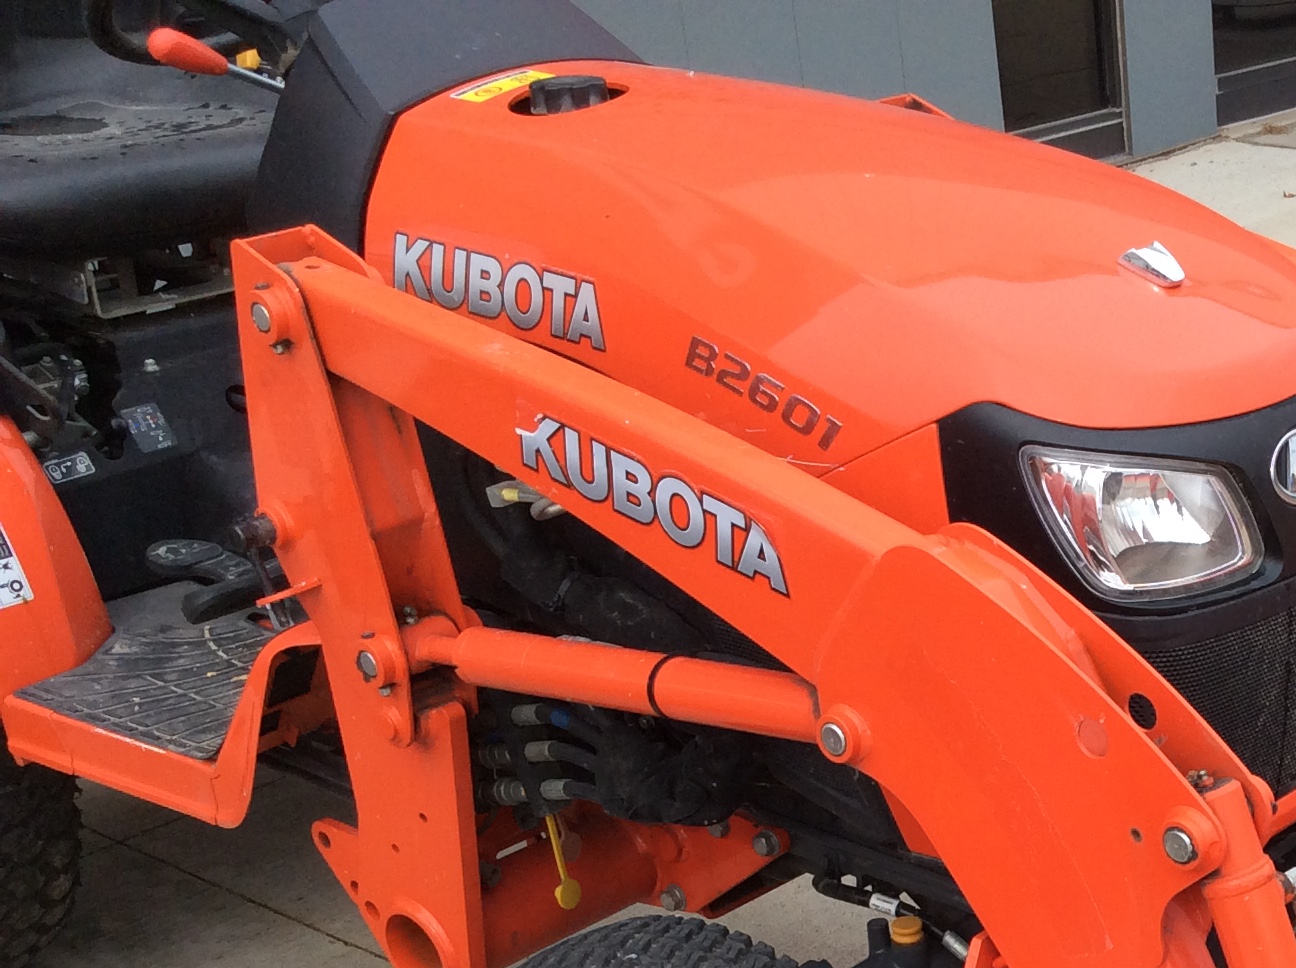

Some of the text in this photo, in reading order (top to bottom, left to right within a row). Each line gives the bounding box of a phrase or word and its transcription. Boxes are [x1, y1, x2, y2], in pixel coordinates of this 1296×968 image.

[394, 231, 606, 352] KUBOTA
[685, 334, 843, 451] B2601
[516, 415, 790, 598] KUBOTA
